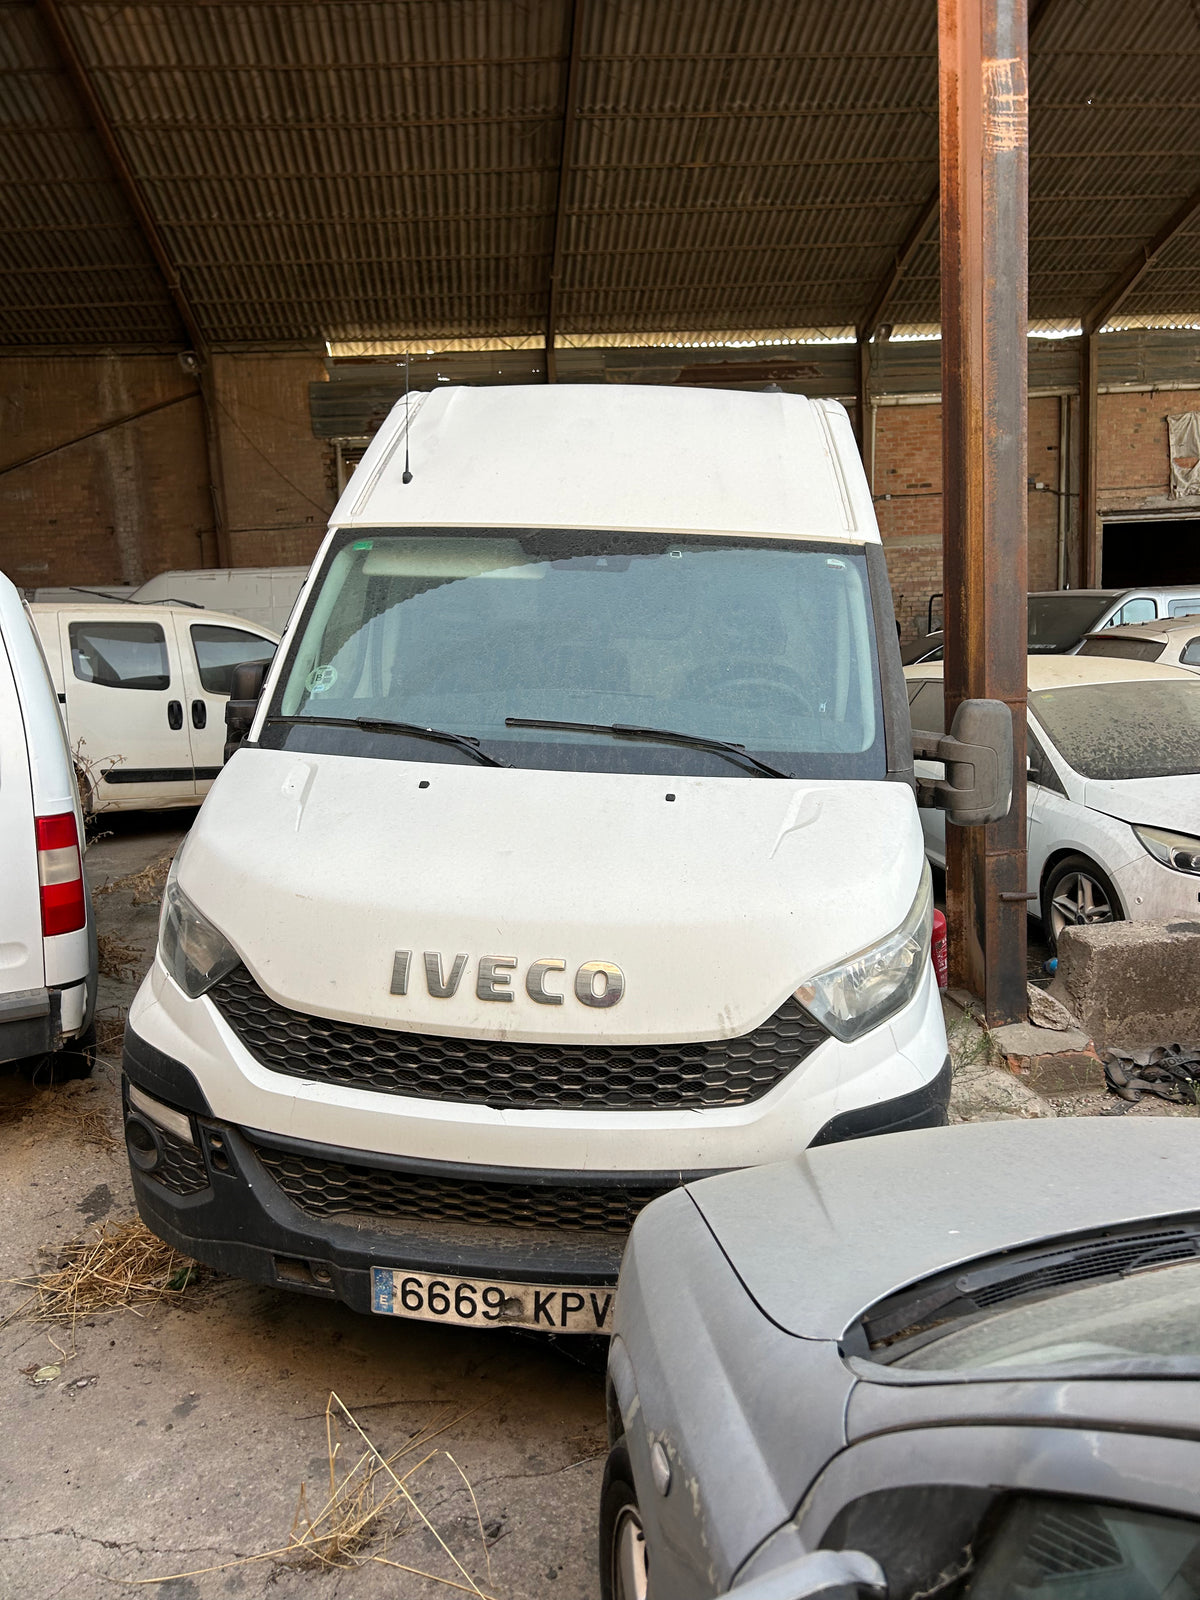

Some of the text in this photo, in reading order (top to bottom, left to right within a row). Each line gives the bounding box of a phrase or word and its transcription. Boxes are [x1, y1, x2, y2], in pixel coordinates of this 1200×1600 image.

[390, 949, 626, 1009] IVECO
[379, 1276, 612, 1328] E 6669 KPV
